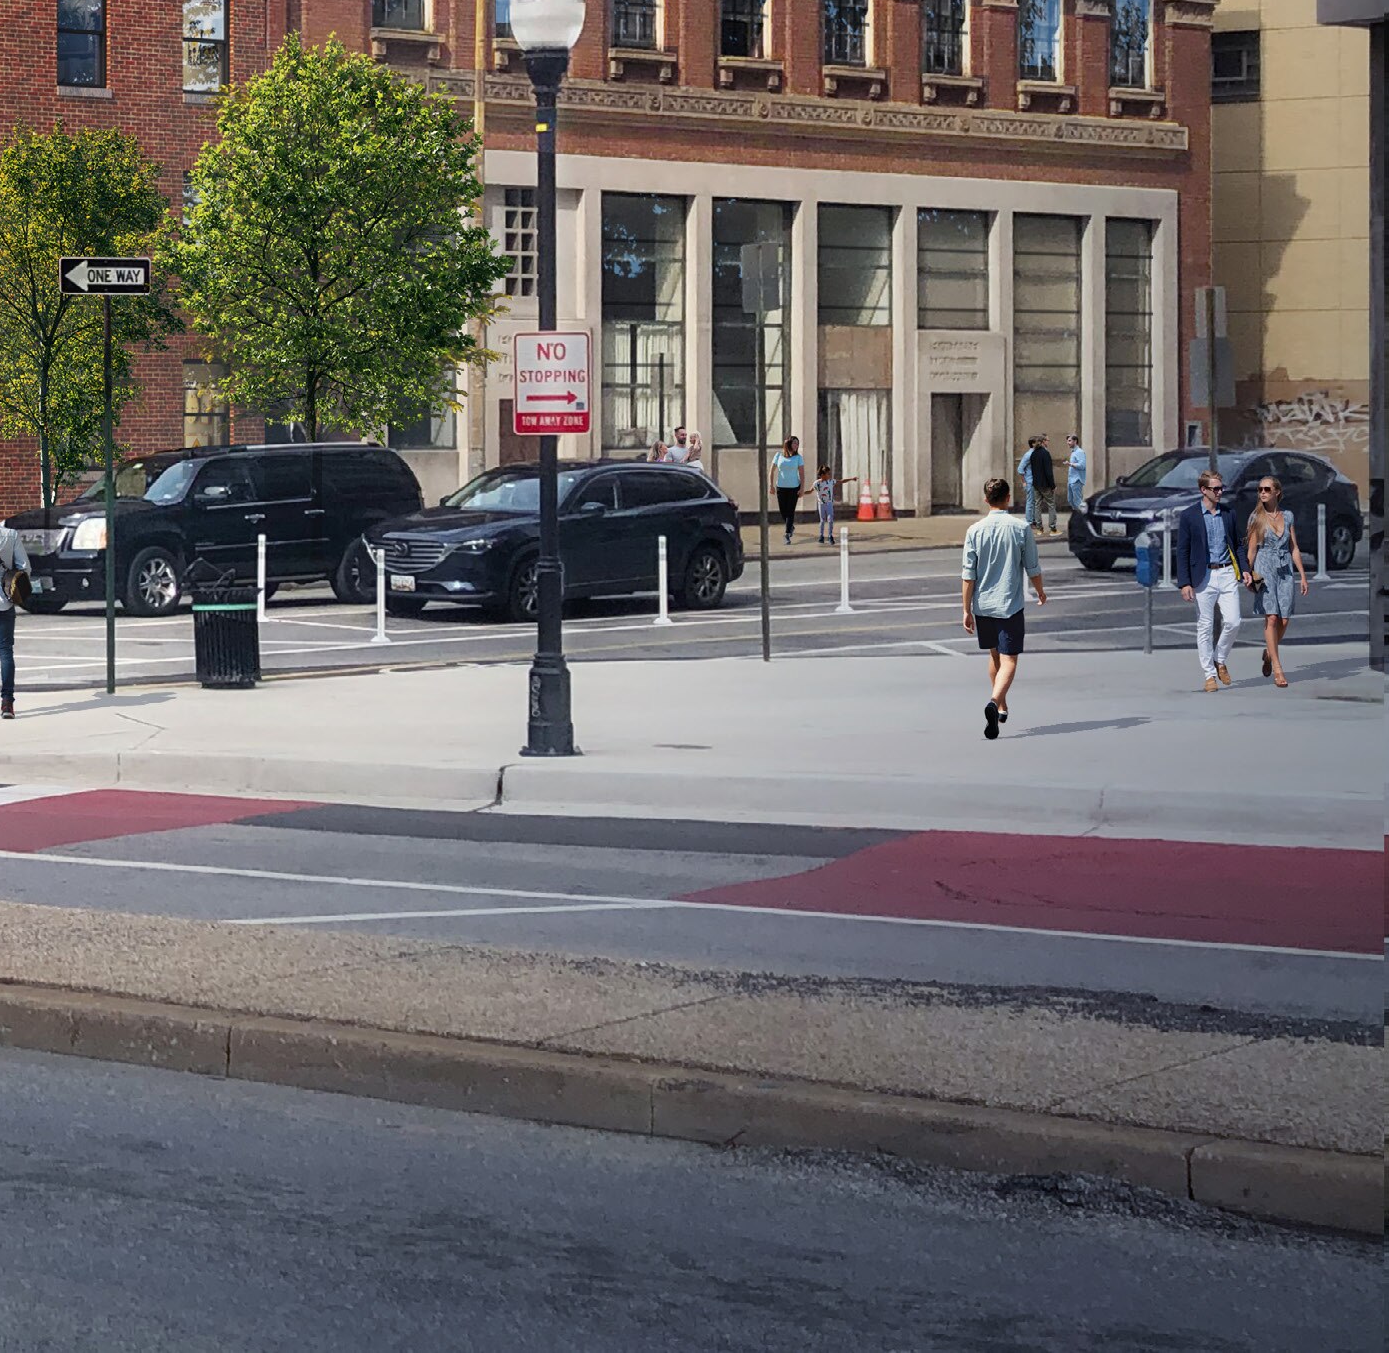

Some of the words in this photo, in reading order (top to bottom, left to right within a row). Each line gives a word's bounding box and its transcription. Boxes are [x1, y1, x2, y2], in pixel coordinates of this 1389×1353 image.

[87, 269, 112, 282] ONE
[115, 269, 141, 282] WAY
[536, 342, 567, 361] NO
[519, 370, 586, 383] STOPPING
[521, 416, 537, 426] TOW
[539, 416, 561, 426] AWAY
[563, 416, 584, 426] ZONE
